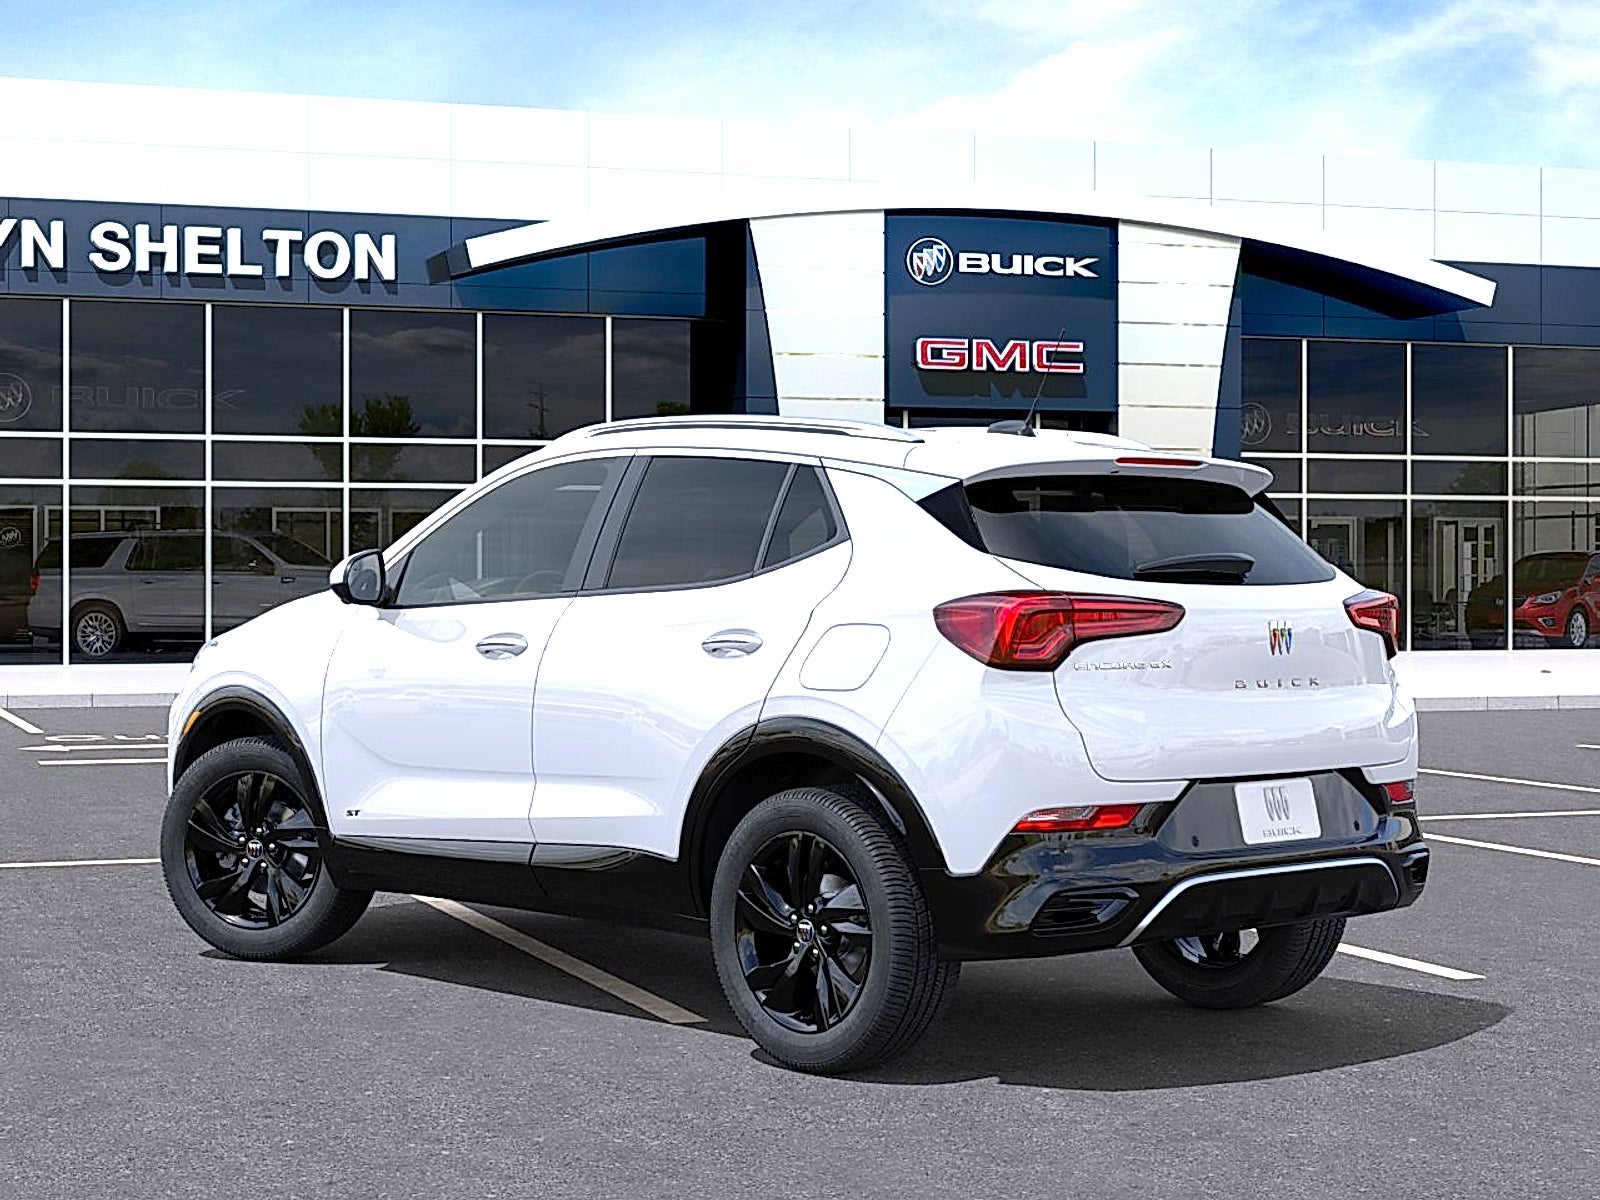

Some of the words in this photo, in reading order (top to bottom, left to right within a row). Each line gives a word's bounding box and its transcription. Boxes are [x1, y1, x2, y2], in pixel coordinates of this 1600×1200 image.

[88, 221, 397, 281] SHELTON
[958, 252, 1100, 278] BUICK
[916, 337, 1084, 374] GMC
[1234, 677, 1320, 689] BUICK
[345, 809, 361, 817] ST
